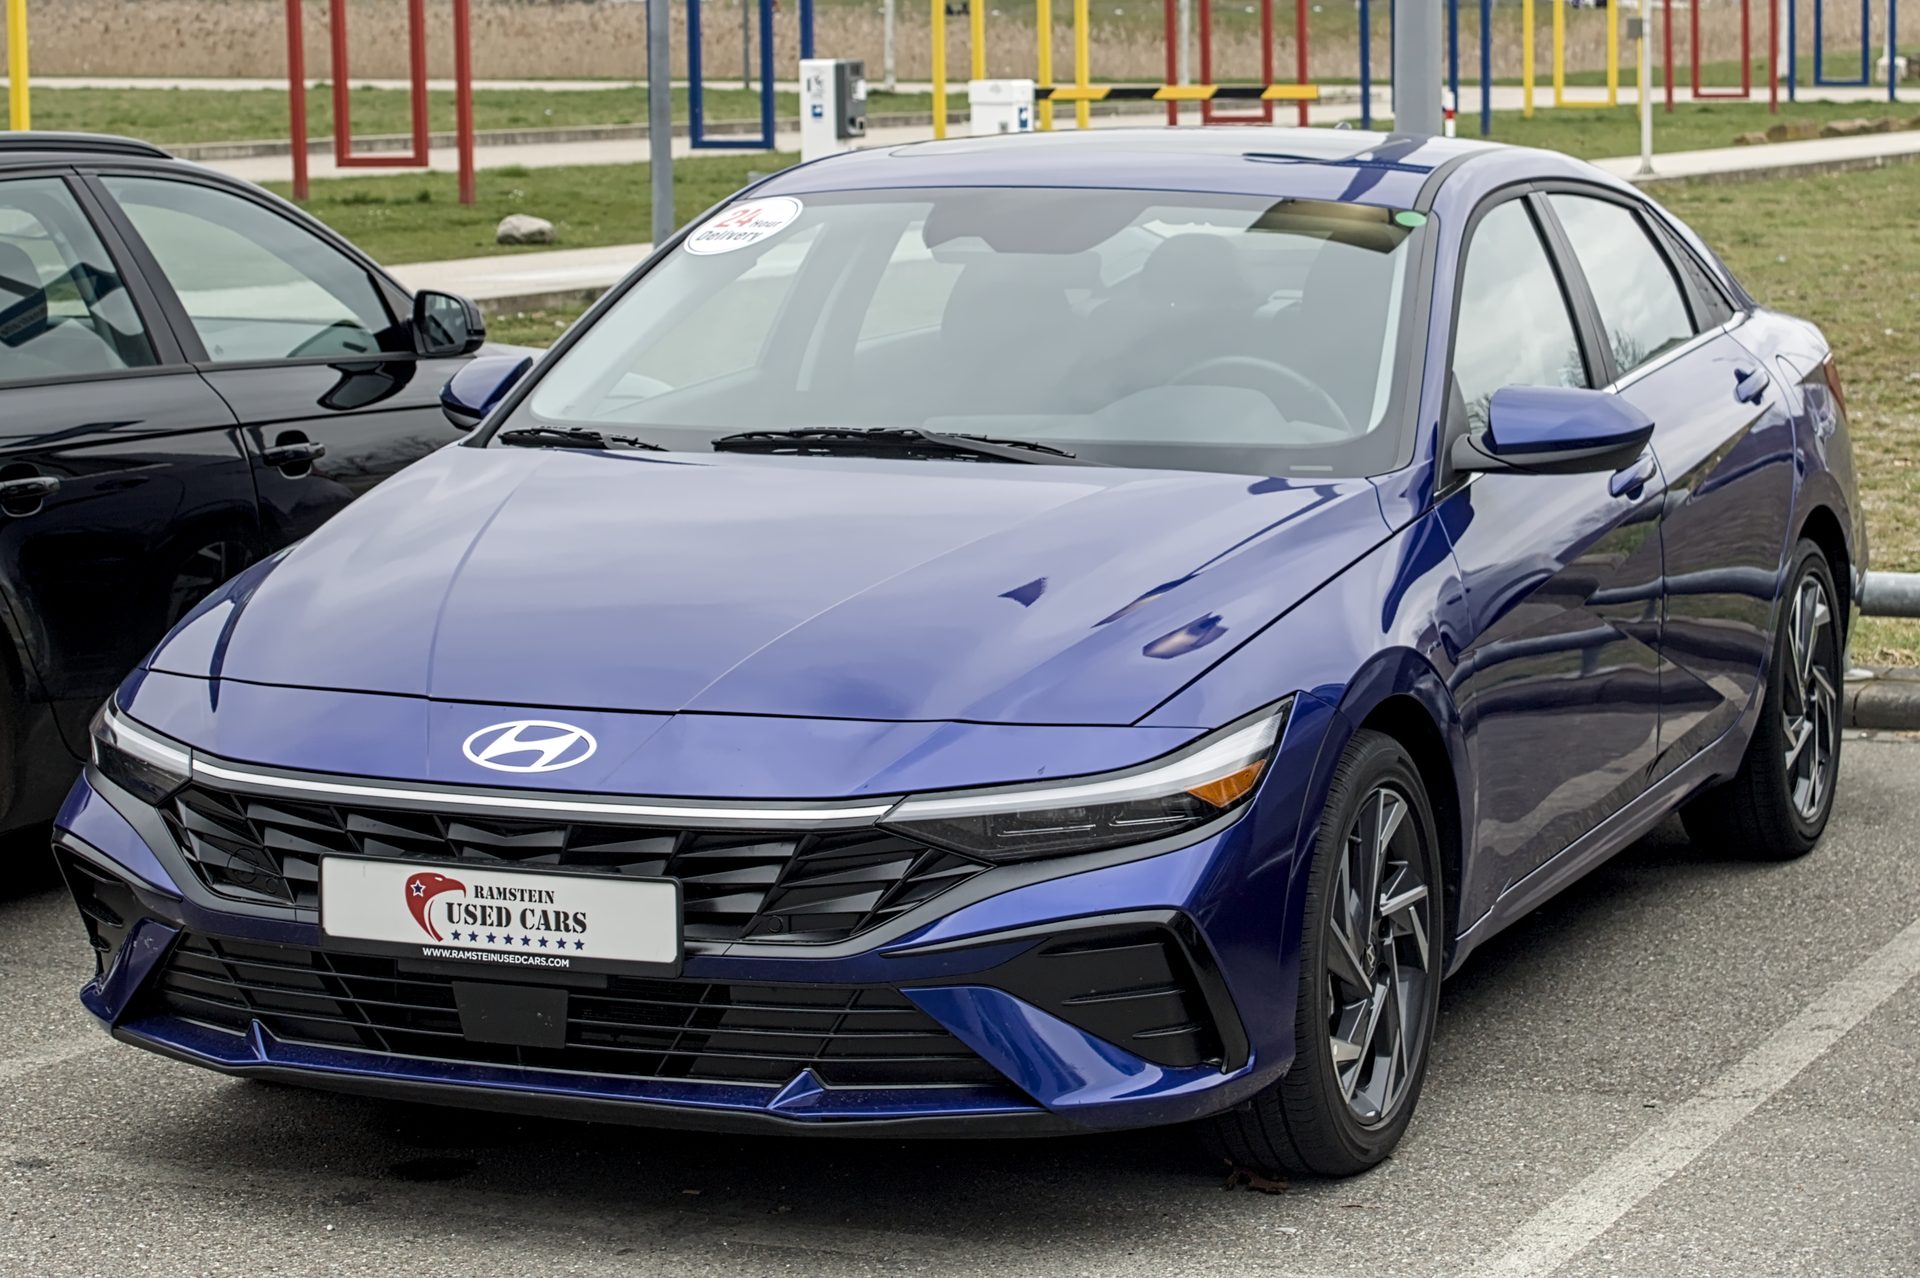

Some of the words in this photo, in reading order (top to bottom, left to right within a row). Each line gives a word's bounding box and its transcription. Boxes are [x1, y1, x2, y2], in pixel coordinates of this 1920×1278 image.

[714, 208, 762, 228] 24
[749, 219, 783, 228] Hour
[695, 231, 764, 242] Delivery
[474, 885, 555, 904] RAMSTEIN
[446, 902, 511, 928] USED
[519, 907, 587, 934] CARS
[422, 947, 569, 967] WWW.RAMSTEINUSEDCARS.COM
